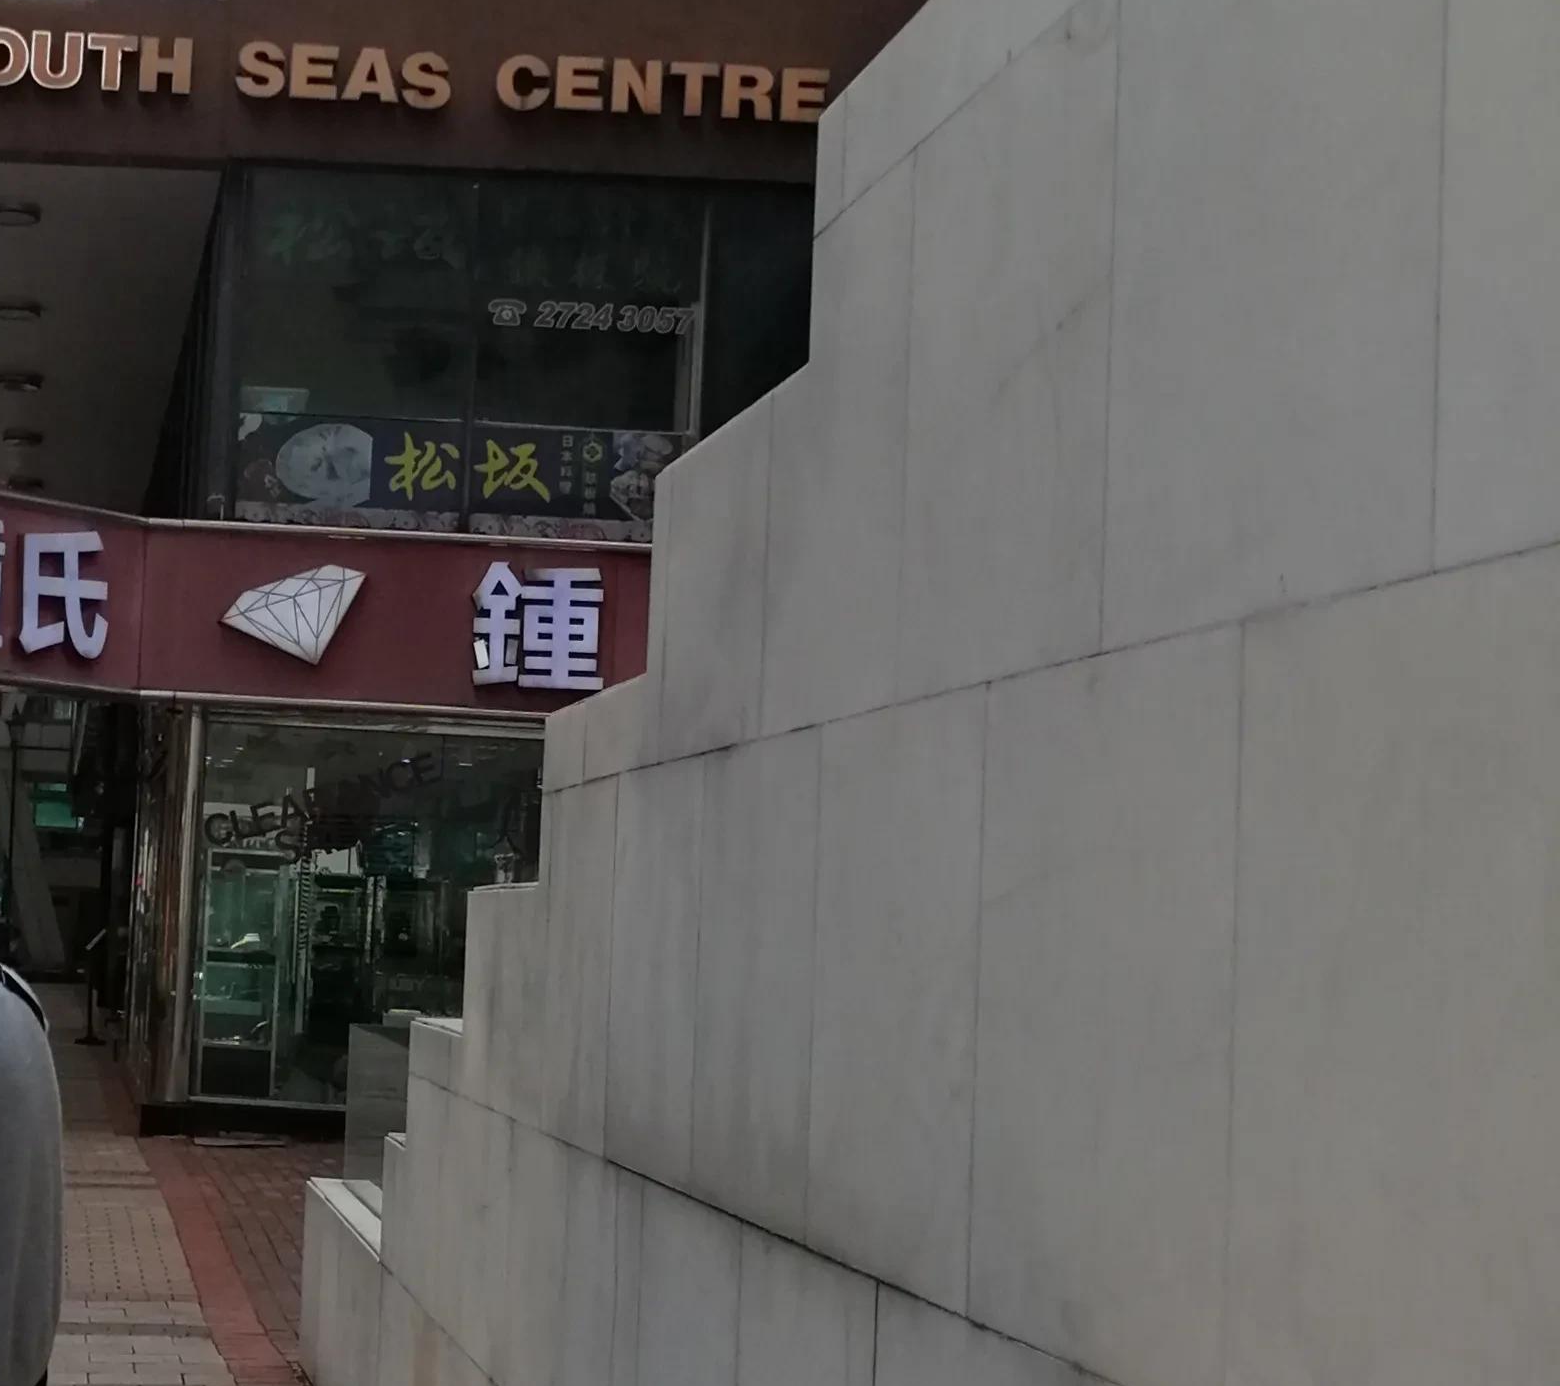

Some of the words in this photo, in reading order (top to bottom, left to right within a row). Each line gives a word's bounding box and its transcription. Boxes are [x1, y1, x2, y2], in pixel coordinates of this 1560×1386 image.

[235, 40, 452, 111] SEAS
[495, 53, 831, 123] CENTRE
[533, 300, 614, 331] 2724
[616, 305, 697, 335] 3057
[384, 431, 551, 503] 松坂
[471, 561, 605, 691] 鍾
[203, 751, 444, 849] CLEANCE
